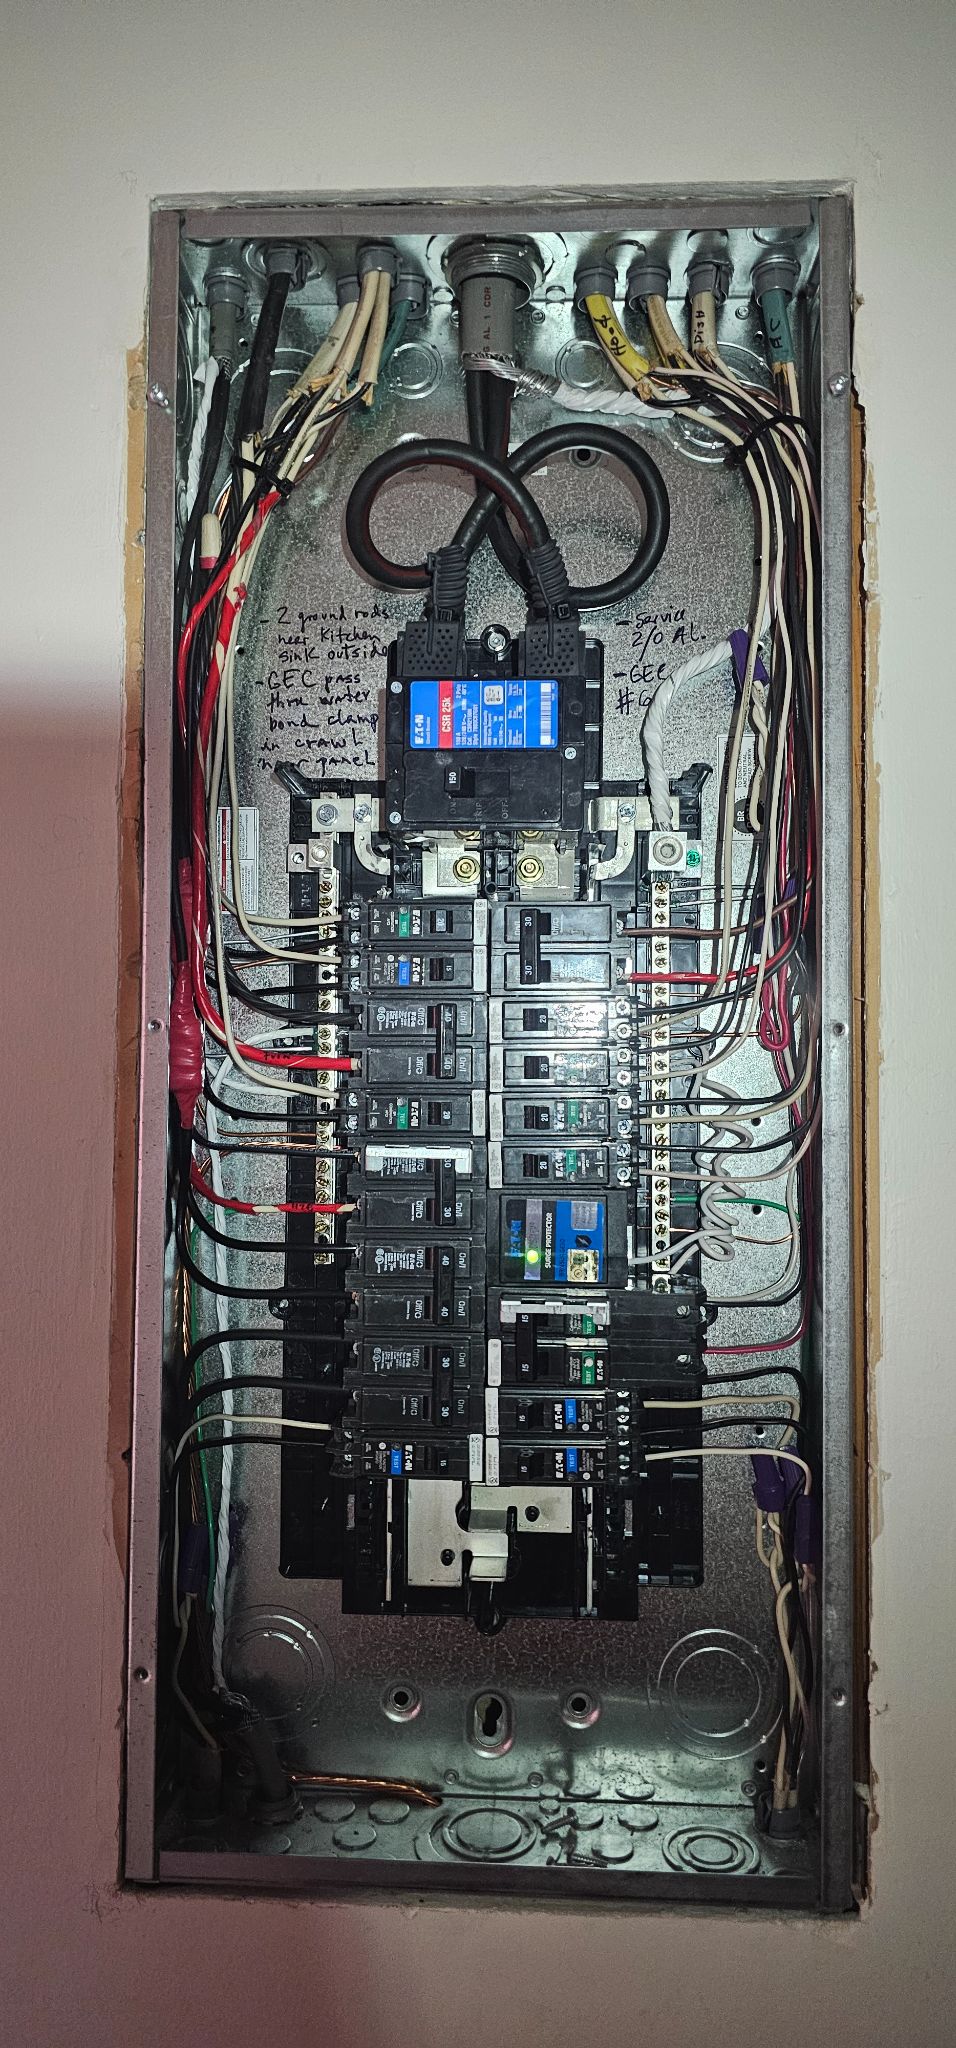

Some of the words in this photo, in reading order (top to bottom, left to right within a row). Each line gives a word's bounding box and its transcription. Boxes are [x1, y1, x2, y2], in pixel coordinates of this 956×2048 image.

[483, 327, 490, 340] AL
[277, 606, 291, 624] 2
[298, 605, 347, 633] ground
[355, 604, 389, 619] rods
[632, 625, 663, 661] 2/0
[327, 641, 388, 660] outside
[319, 685, 370, 706] water
[442, 697, 451, 713] 25k
[270, 713, 319, 732] bond
[328, 709, 379, 733] clamp
[442, 715, 451, 733] CSR
[261, 738, 279, 751] in
[737, 810, 745, 822] BR
[525, 916, 532, 927] 30
[525, 965, 533, 976] 30
[540, 1015, 547, 1023] 20
[541, 1064, 548, 1072] 20
[443, 1111, 450, 1119] 20
[541, 1113, 548, 1122] 20
[540, 1161, 547, 1170] 20
[444, 1207, 451, 1218] 30
[442, 1256, 450, 1266] 40
[441, 1307, 449, 1317] 40
[522, 1314, 529, 1323] 15
[442, 1357, 450, 1368] 30
[522, 1363, 529, 1372] 15
[441, 1407, 449, 1417] 30
[556, 1452, 564, 1479] EATON
